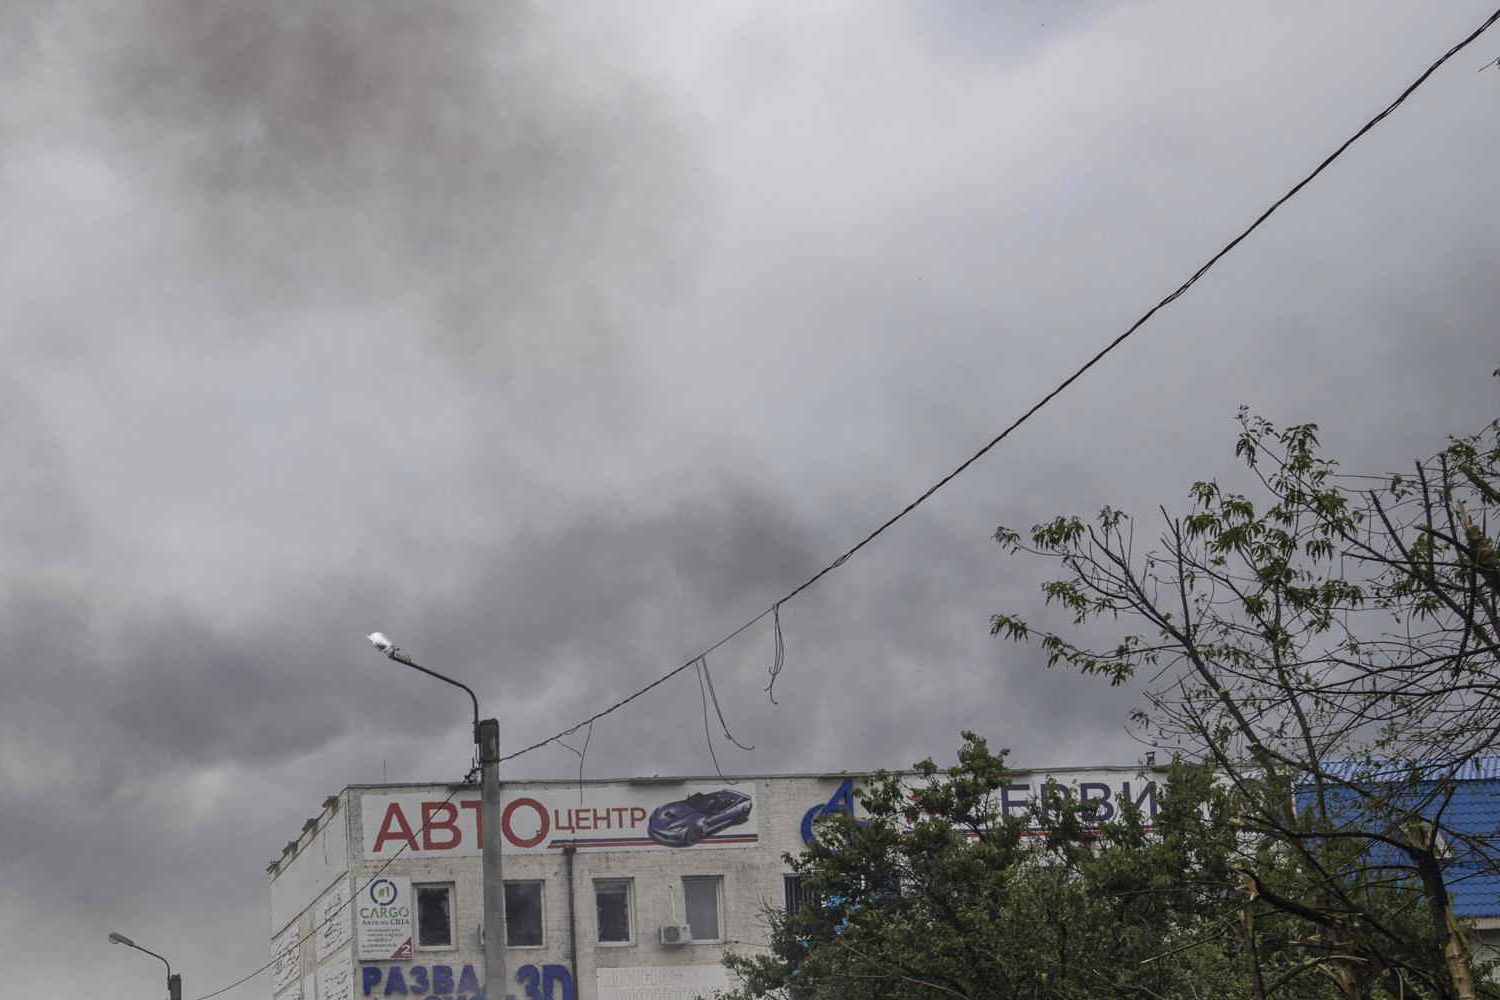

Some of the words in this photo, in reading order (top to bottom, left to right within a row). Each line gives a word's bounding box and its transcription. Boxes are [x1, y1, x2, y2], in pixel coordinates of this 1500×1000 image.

[999, 781, 1158, 824] ЕРВИ
[372, 797, 550, 852] АВТО
[555, 806, 646, 834] ЦЕНТР
[378, 886, 389, 898] #1
[360, 907, 409, 919] CARGO
[362, 964, 486, 996] РАЗВА
